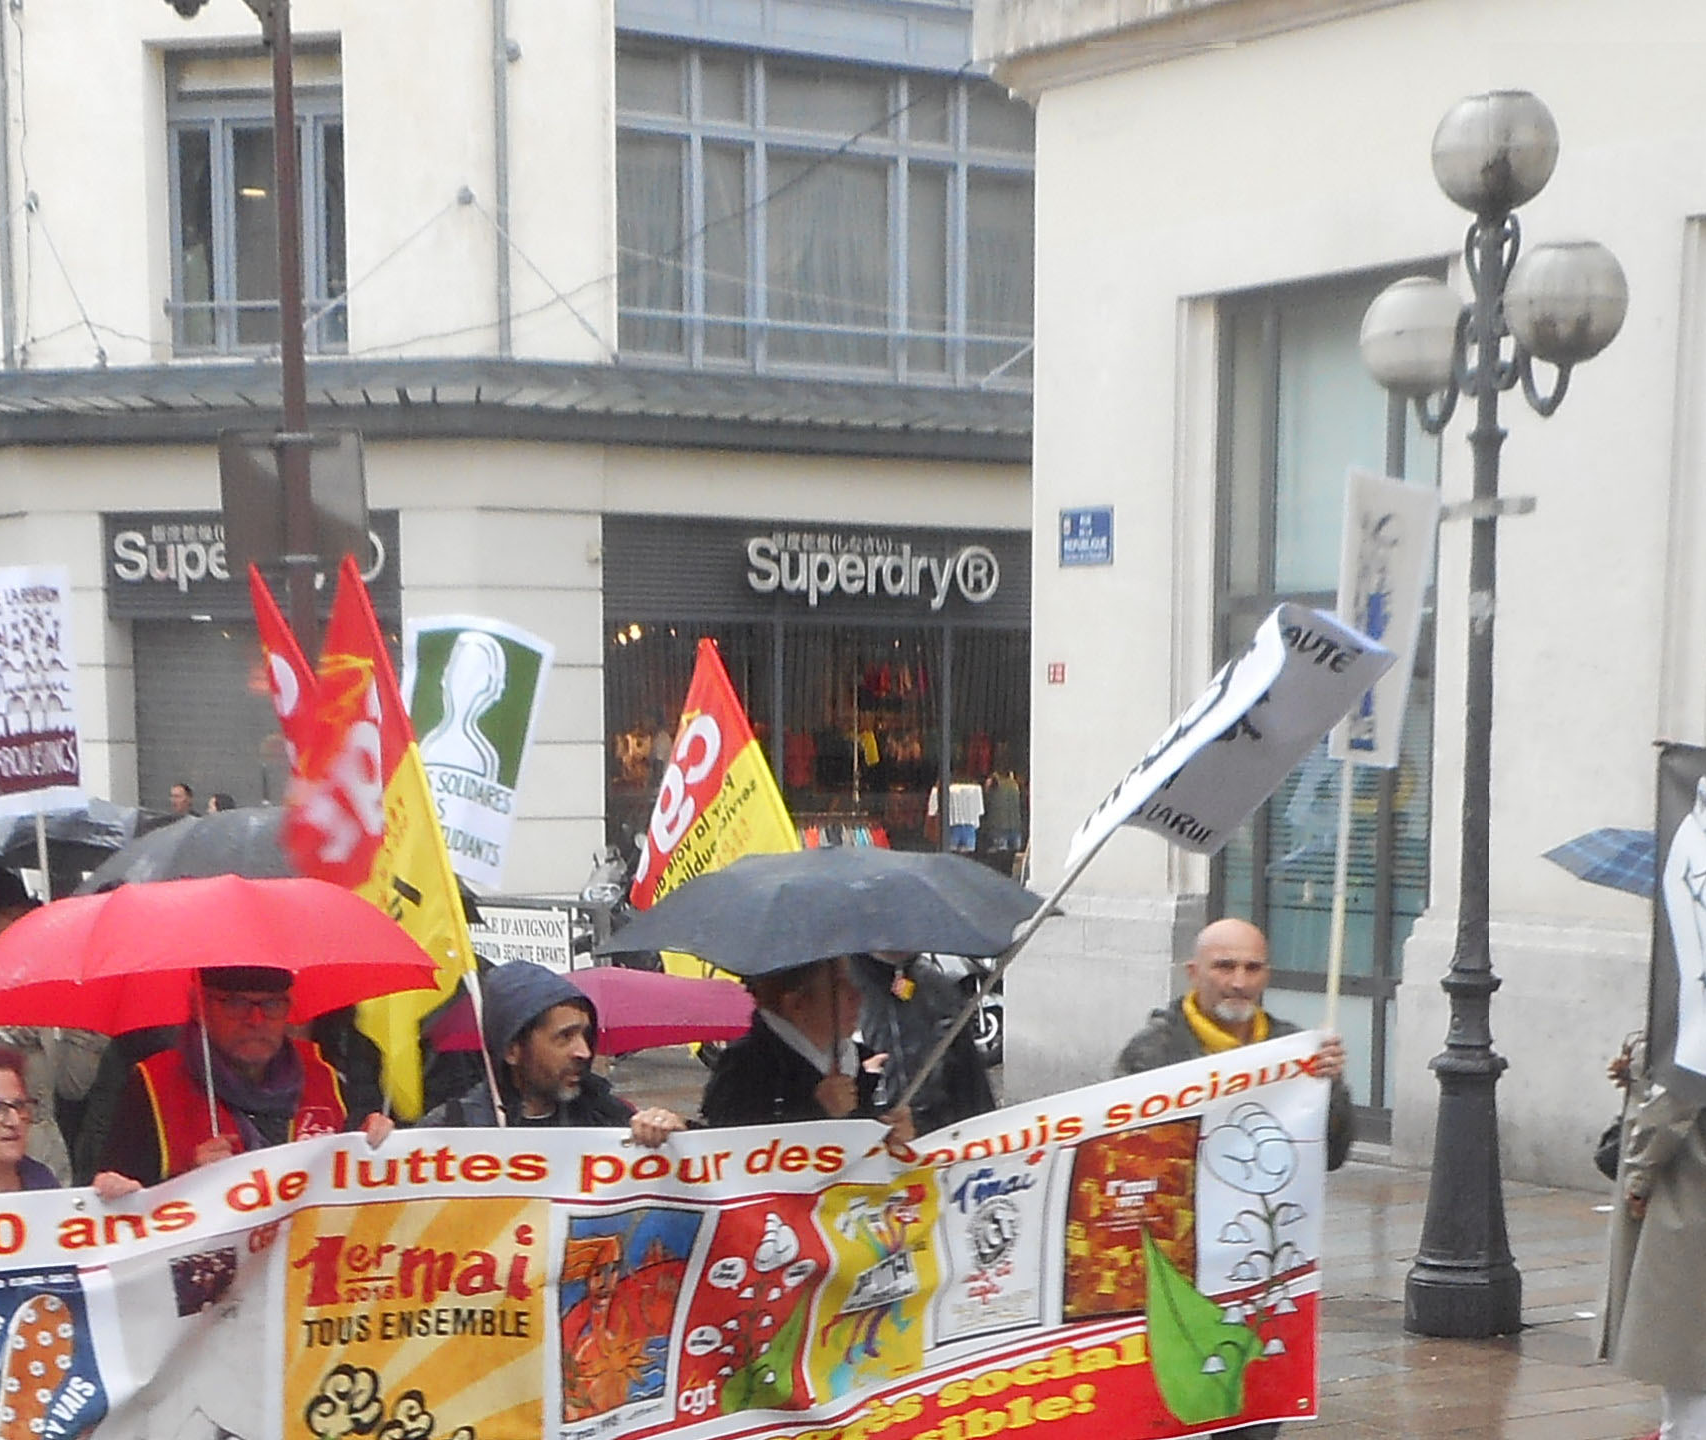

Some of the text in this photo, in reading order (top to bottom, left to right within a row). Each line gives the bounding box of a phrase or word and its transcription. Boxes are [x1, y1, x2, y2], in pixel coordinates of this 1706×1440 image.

[57, 1199, 197, 1249] ans
[226, 1169, 308, 1212] de
[332, 1145, 549, 1189] luttes
[579, 1149, 734, 1193] pour
[744, 1138, 844, 1175] des
[1103, 1055, 1321, 1129] sociaux
[291, 1235, 397, 1307] 1er
[399, 1224, 533, 1303] mai
[302, 1307, 530, 1348] TOUS ENSEMBLE
[51, 1376, 96, 1422] VAIS
[679, 1379, 717, 1415] cgt
[936, 1335, 1147, 1405] social
